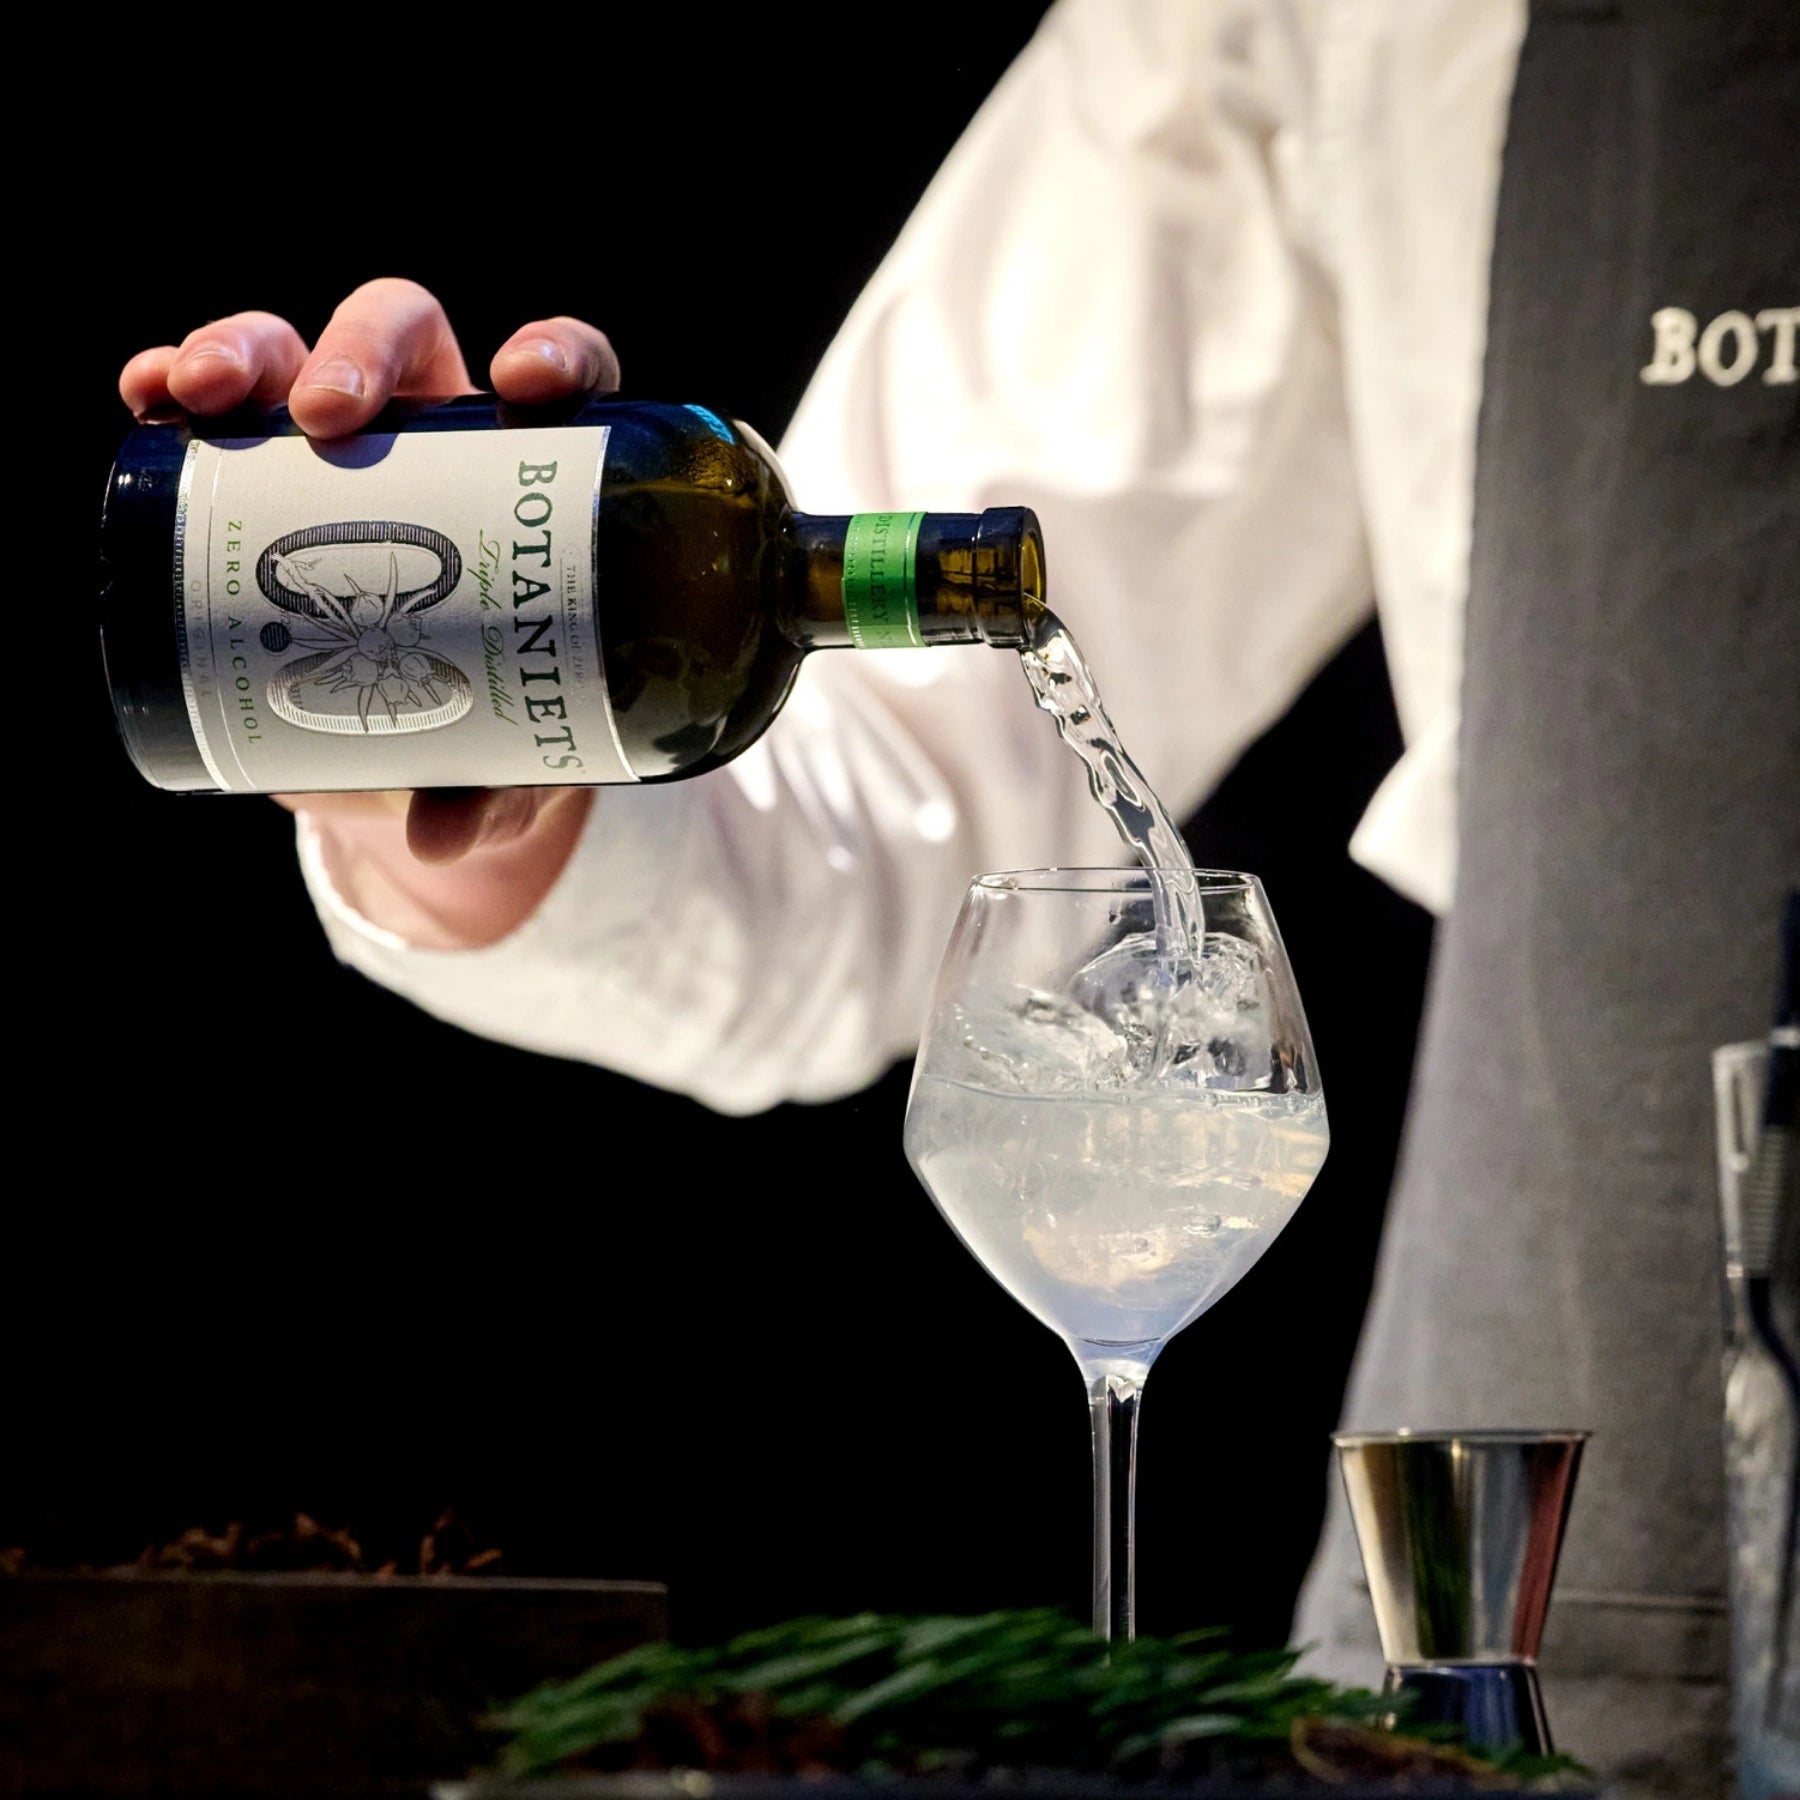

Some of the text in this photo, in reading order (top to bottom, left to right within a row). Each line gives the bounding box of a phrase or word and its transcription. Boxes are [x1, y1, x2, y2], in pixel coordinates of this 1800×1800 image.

[512, 460, 584, 769] BOTANIETS
[566, 565, 577, 594] THE
[567, 597, 578, 631] KING
[870, 514, 893, 623] DISTILLERY
[190, 580, 212, 697] ORIGINAL
[225, 520, 262, 744] ZERO ALCOHOL
[467, 528, 519, 726] Triple Distilled
[568, 634, 581, 651] OF
